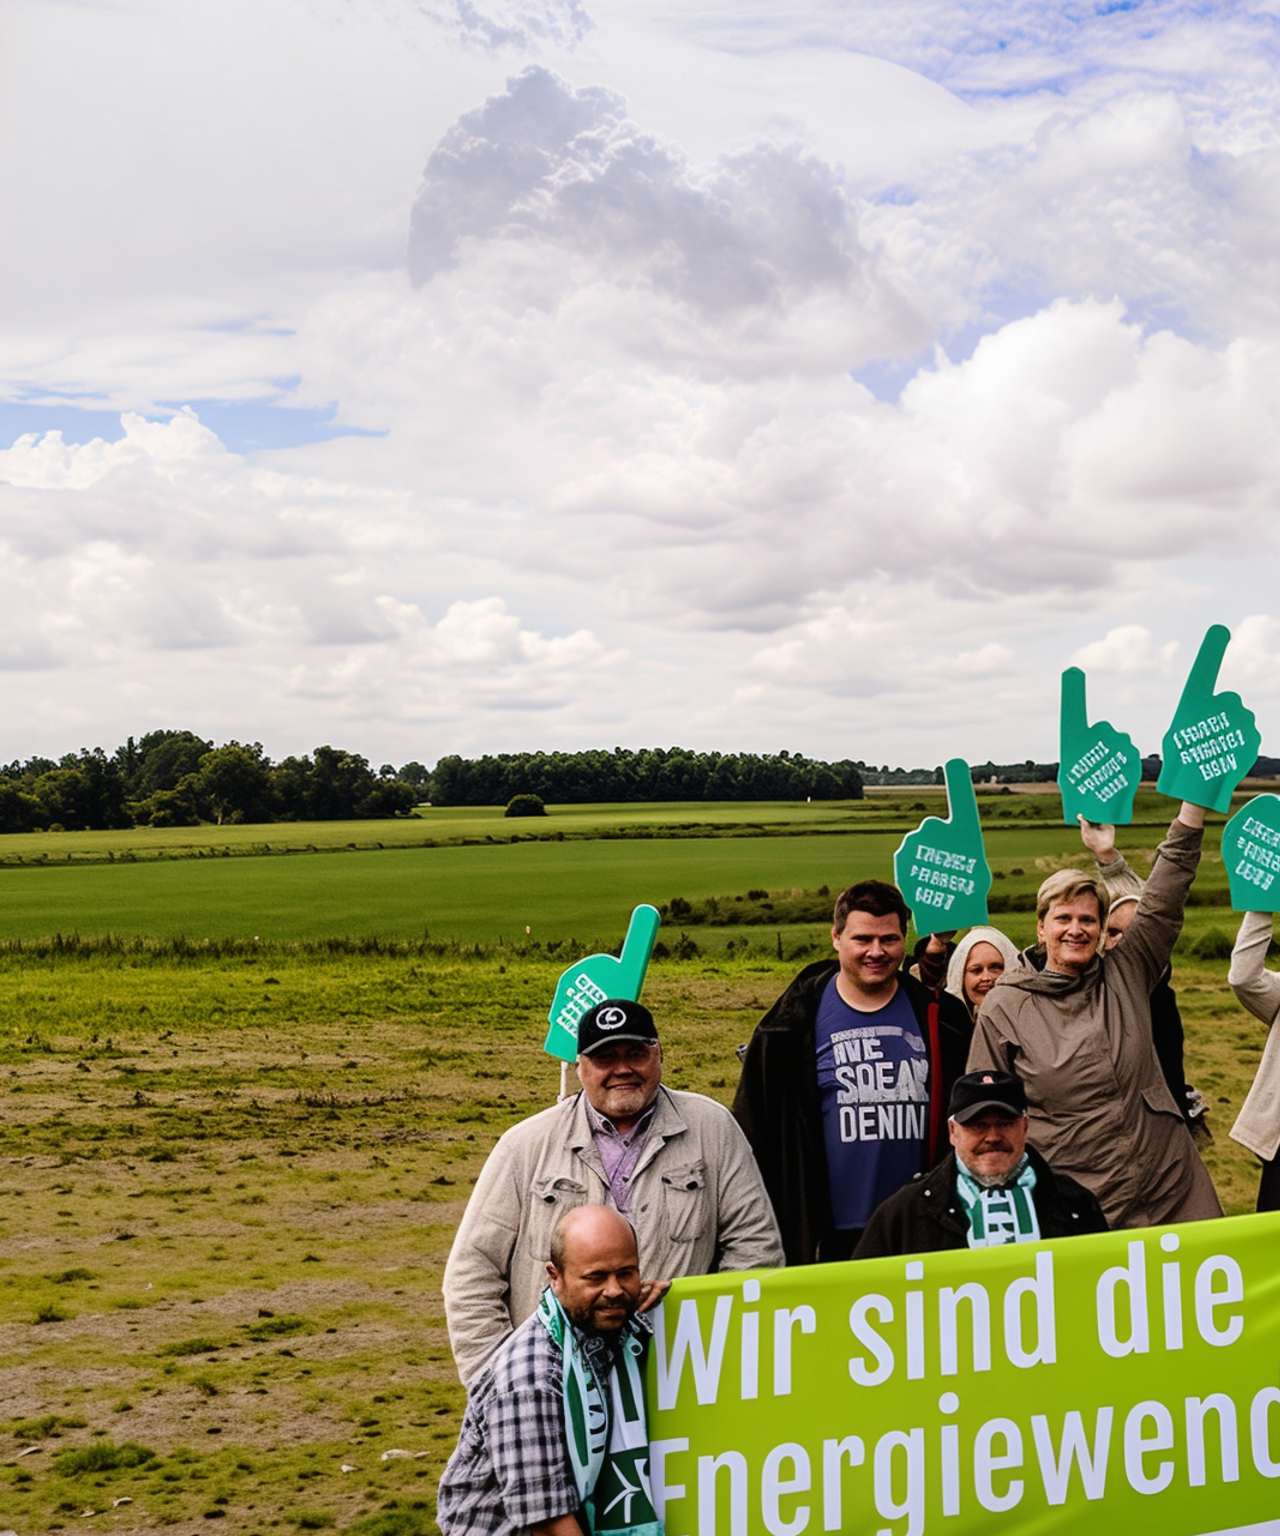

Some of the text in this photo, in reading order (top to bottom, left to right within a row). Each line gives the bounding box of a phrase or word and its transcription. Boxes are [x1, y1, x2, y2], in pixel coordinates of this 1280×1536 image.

[649, 1233, 1245, 1411] Wir sind die
